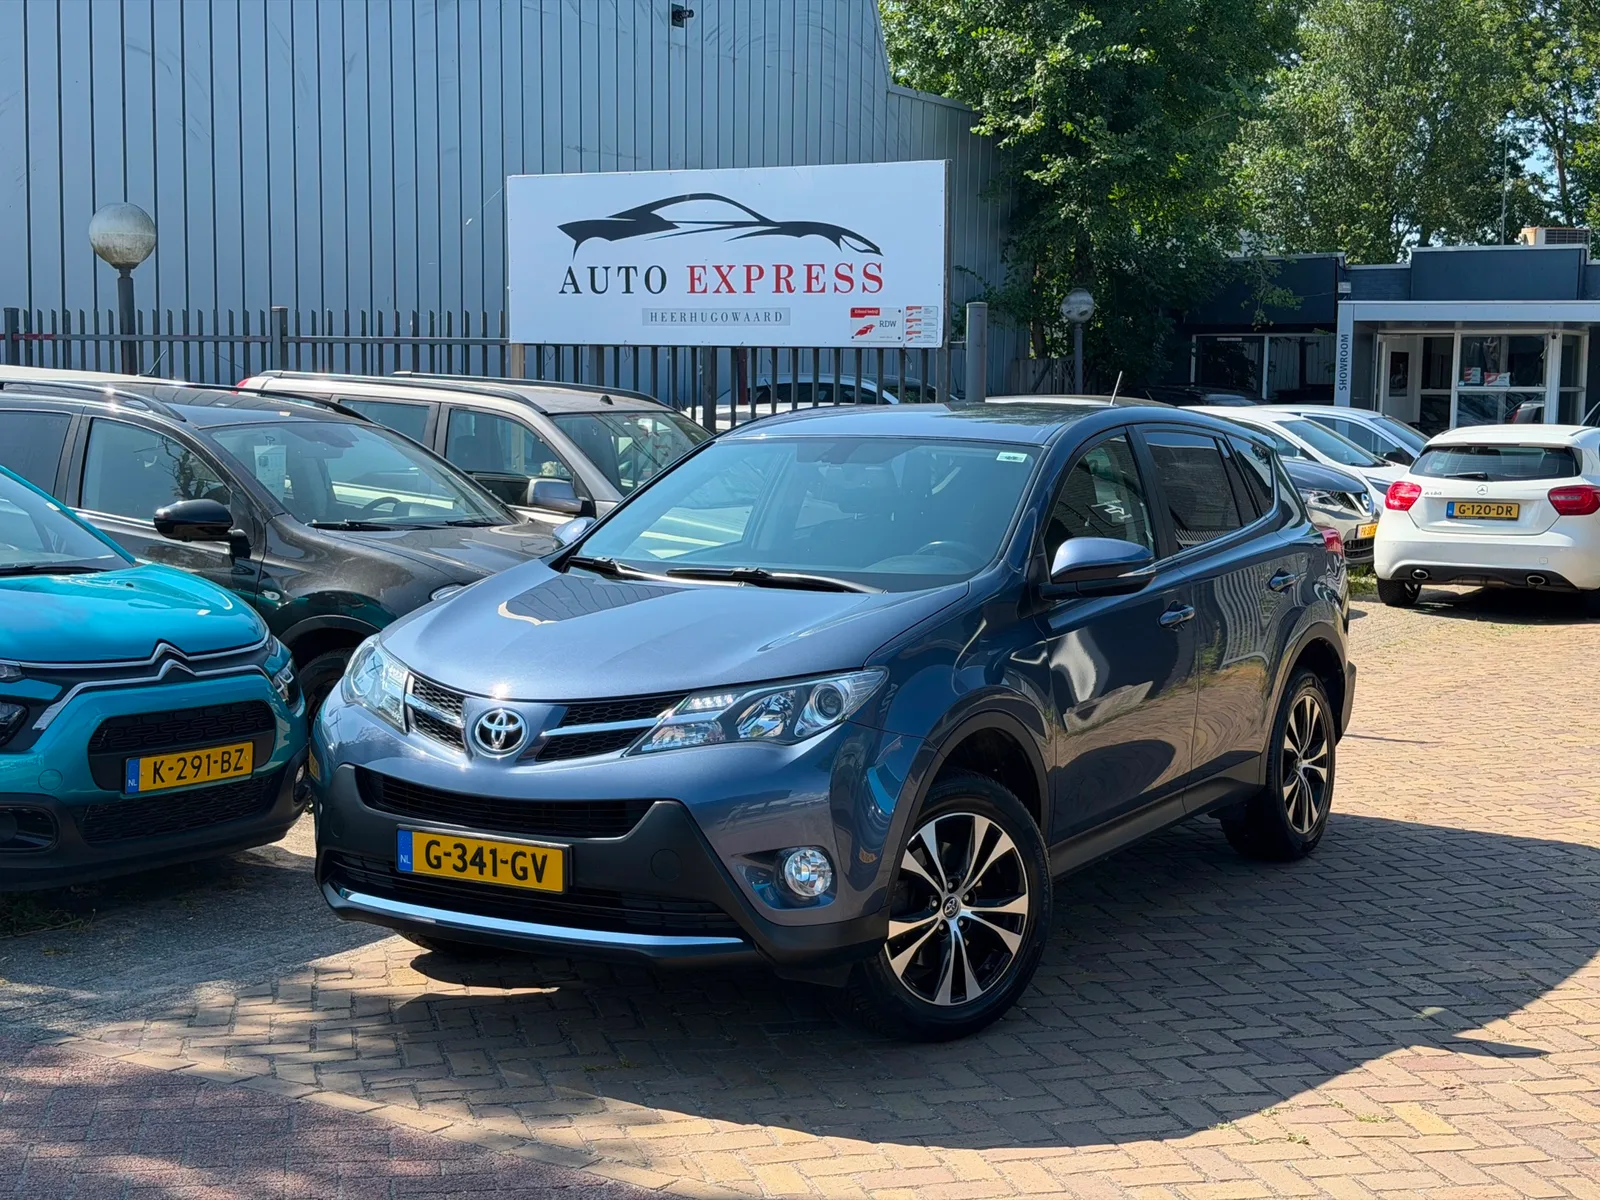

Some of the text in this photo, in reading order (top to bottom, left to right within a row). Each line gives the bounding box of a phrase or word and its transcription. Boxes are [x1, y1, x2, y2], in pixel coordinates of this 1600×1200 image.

[558, 262, 884, 295] AUTO EXPRESS
[649, 311, 784, 323] HEERHUGOWAARD
[879, 320, 897, 328] RDW
[1338, 333, 1350, 391] SHOWROOM
[1458, 503, 1514, 517] G-120-DR
[127, 748, 245, 787] NL K-291-BZ
[400, 839, 548, 884] NL G-341-GV
